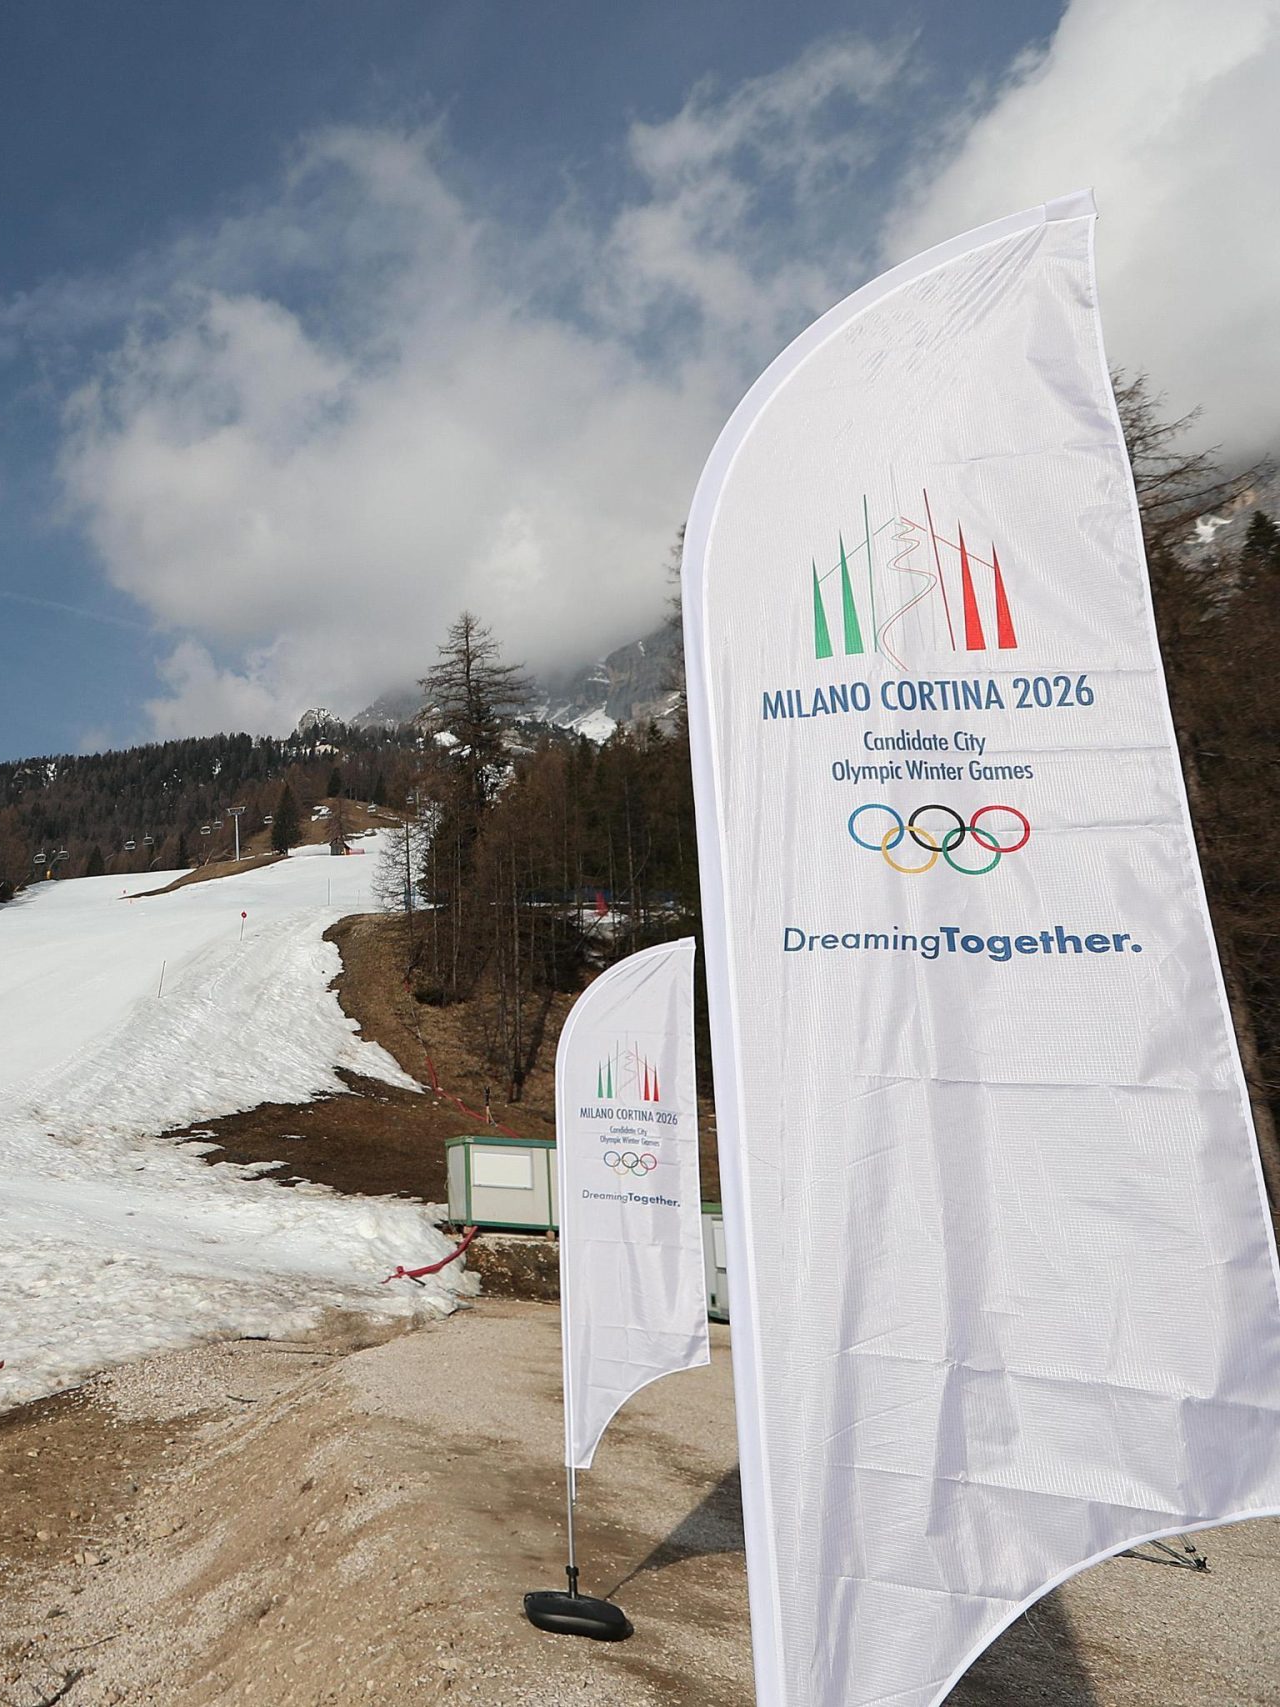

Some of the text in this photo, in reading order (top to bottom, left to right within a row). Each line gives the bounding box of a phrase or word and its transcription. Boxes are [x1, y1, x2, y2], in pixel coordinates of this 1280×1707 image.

[762, 674, 1095, 719] MILANO CORTINA 2026
[863, 729, 987, 755] Candidate City
[831, 759, 1034, 784] Olympic Winter Games
[580, 1107, 678, 1126] MILANO CORTINA 2026
[609, 1125, 647, 1136] Candidate City
[622, 1137, 640, 1145] Winter
